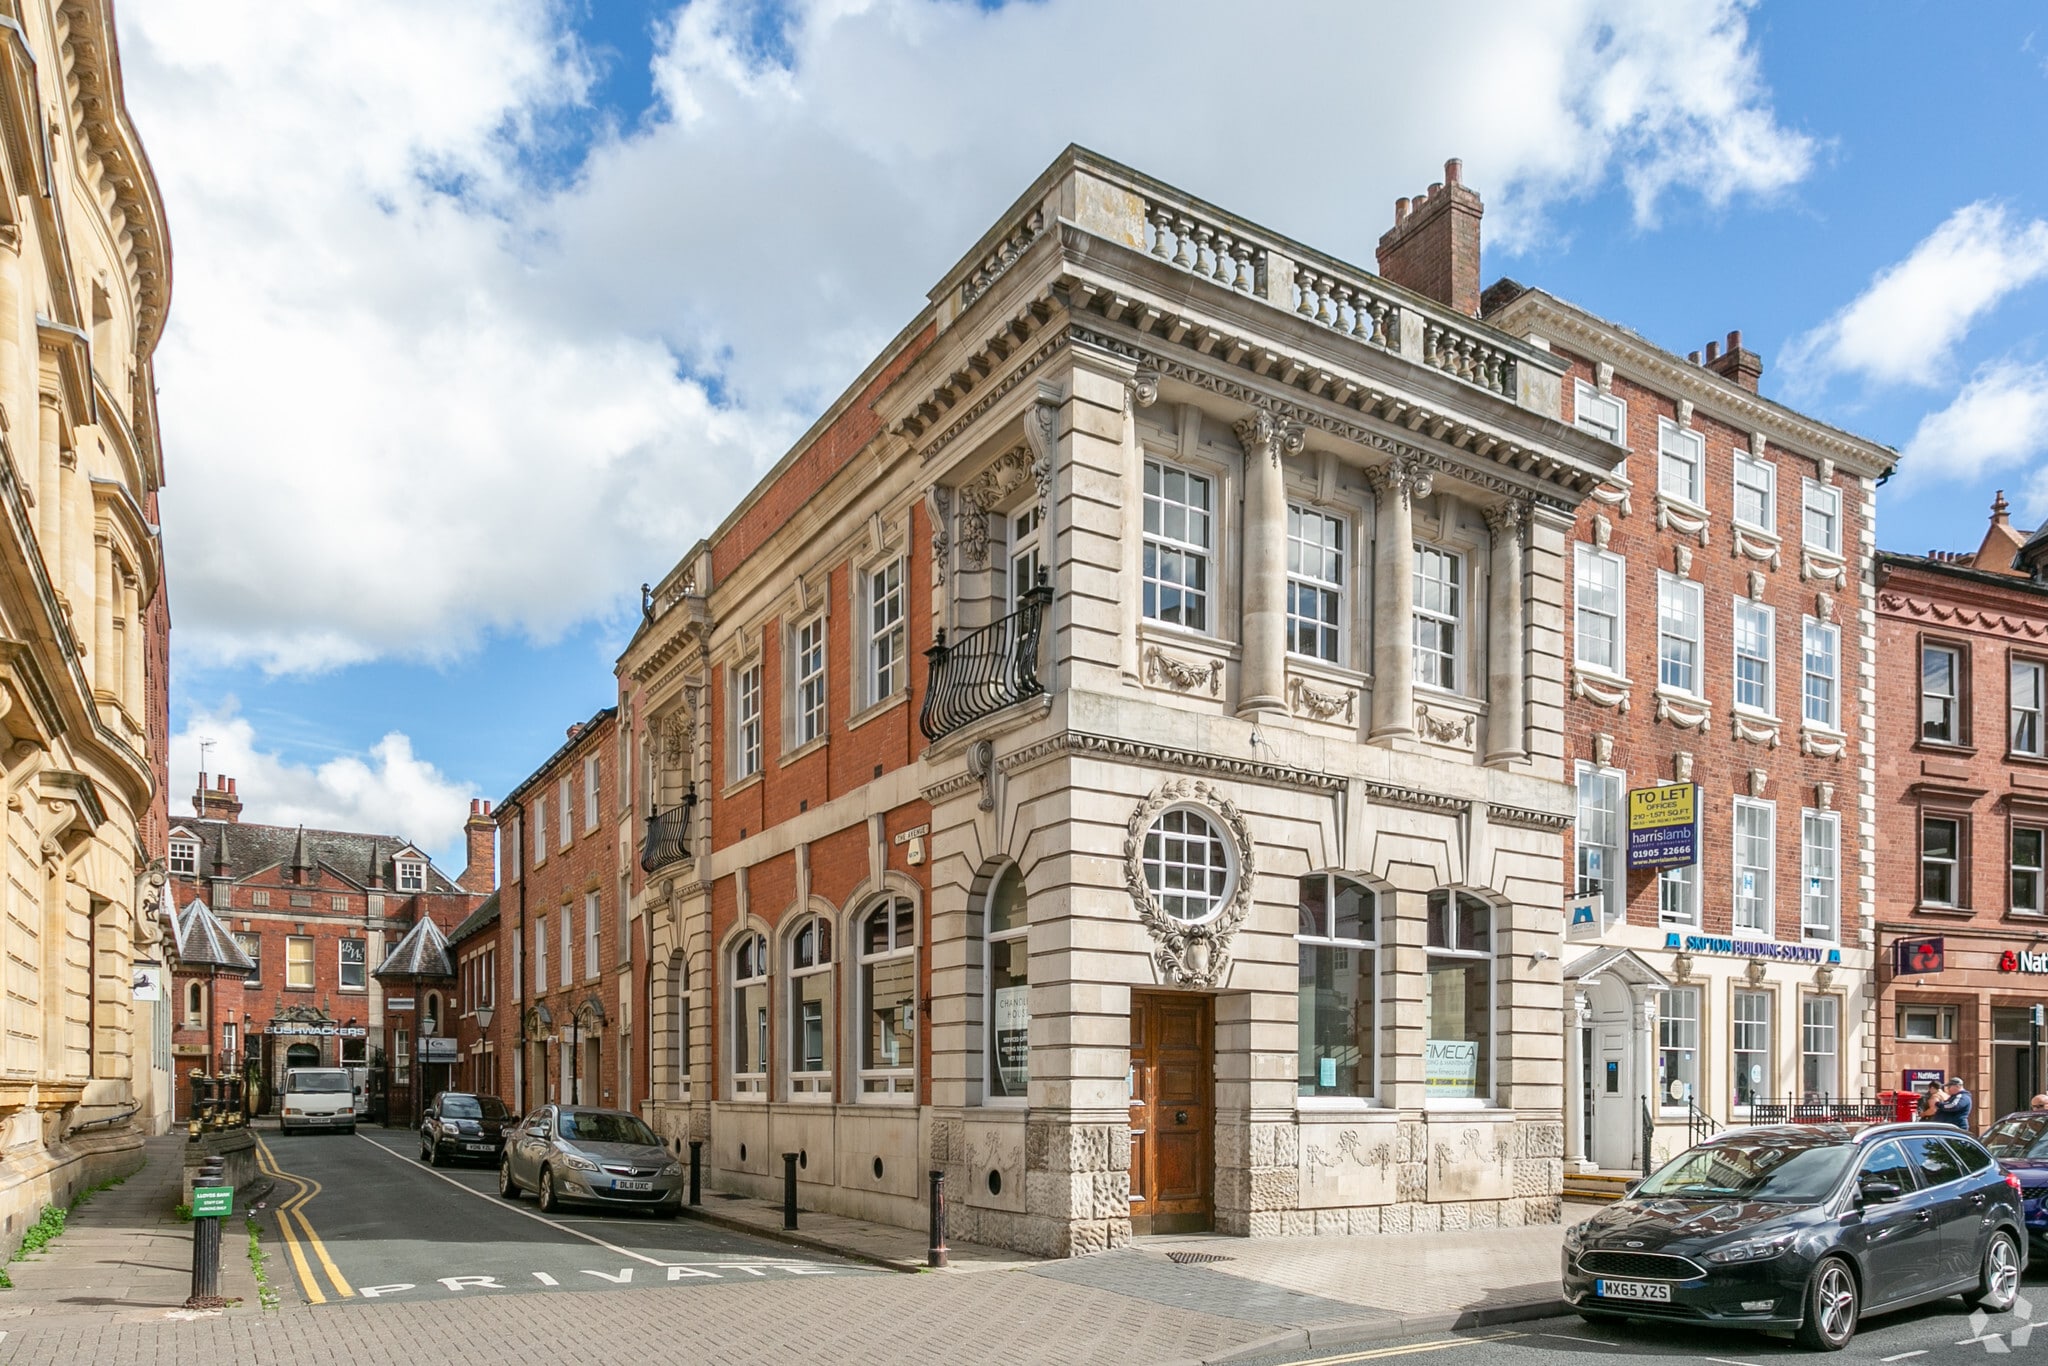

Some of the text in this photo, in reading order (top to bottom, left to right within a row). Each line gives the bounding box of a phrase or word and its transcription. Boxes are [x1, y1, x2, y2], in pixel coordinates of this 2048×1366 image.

[1636, 787, 1688, 804] TO LET
[1646, 802, 1677, 810] OFFICES
[897, 827, 925, 841] THE AVENUE
[1632, 826, 1691, 844] harrislamb
[1632, 845, 1691, 858] 01905 22666
[1632, 855, 1691, 866] www.harrislamb.com
[1686, 935, 1823, 962] SKIPTON BUILDING SOCIETY
[2020, 951, 2048, 973] Nat
[264, 1026, 366, 1037] BUSHWACKERS
[1917, 1072, 1941, 1080] NatWest
[620, 1181, 649, 1190] DL11 UXC
[359, 1266, 836, 1298] PRIVATE
[1605, 1282, 1667, 1299] MX65 XZS
